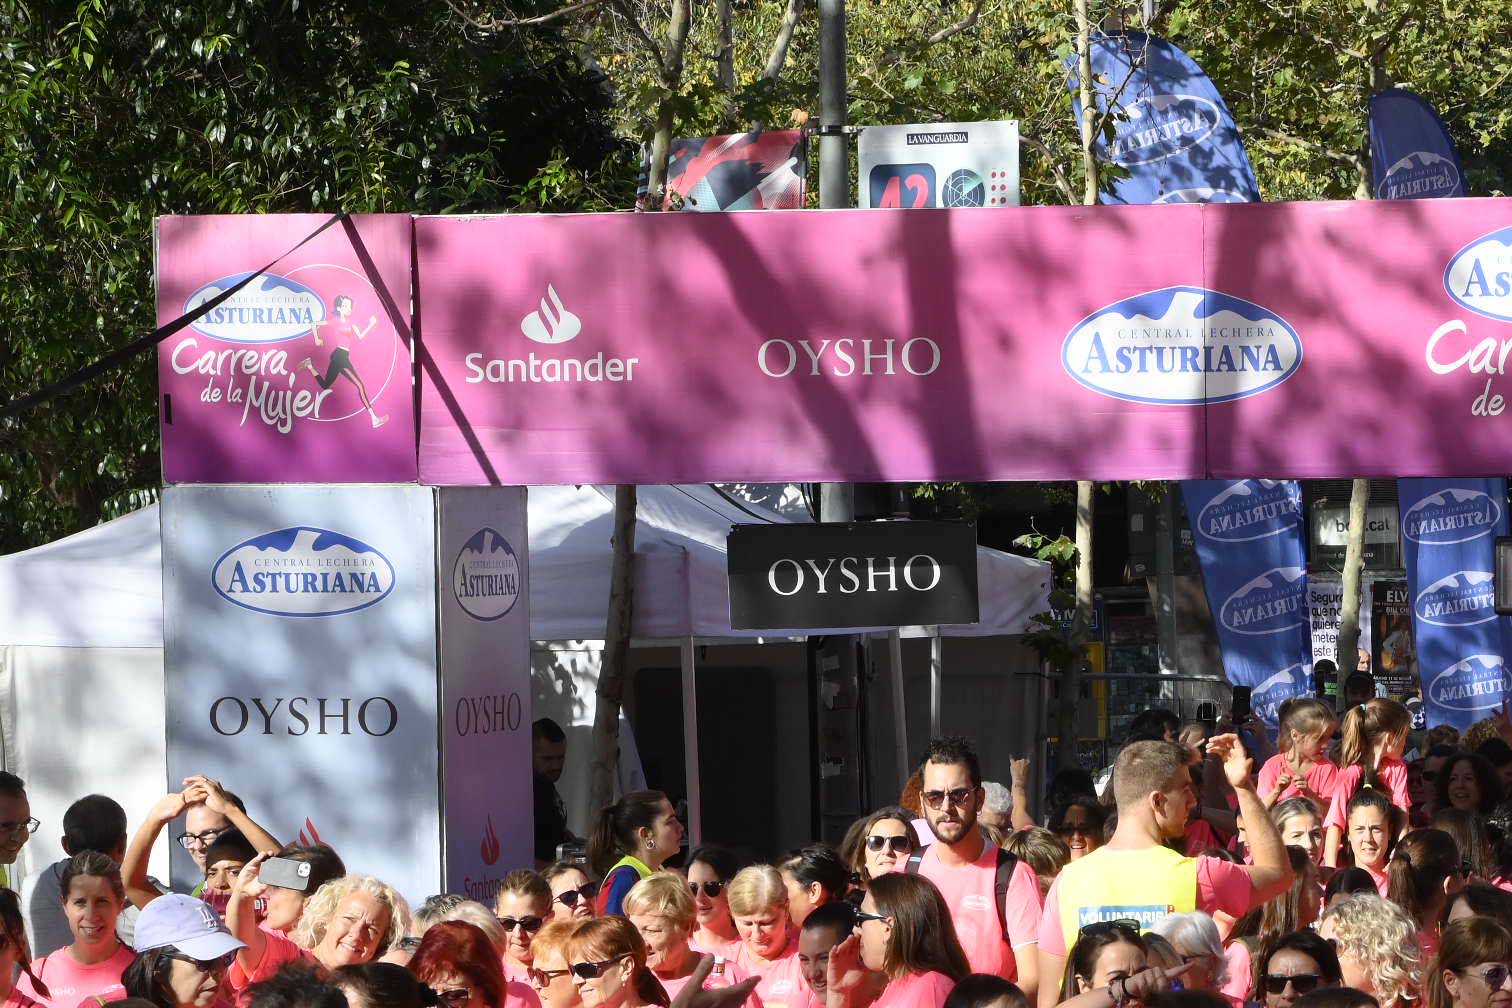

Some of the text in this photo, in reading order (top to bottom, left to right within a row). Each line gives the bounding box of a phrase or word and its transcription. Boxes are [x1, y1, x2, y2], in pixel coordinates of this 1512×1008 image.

[196, 297, 314, 327] ASTURIANA
[1117, 327, 1276, 339] CENTRAL LECHERA
[171, 338, 290, 376] Carrera
[465, 350, 640, 385] Santander
[757, 336, 941, 378] OYSHO
[1082, 331, 1284, 375] ASTURIANA
[200, 372, 334, 434] de la Mujer
[1471, 378, 1505, 416] de
[226, 560, 382, 595] ASTURIANA
[253, 558, 376, 567] CENTRAL LECHERA
[458, 563, 517, 598] ASTURIANA
[766, 553, 942, 597] OYSHO
[209, 696, 399, 738] OYSHO
[455, 692, 522, 738] OYSHO
